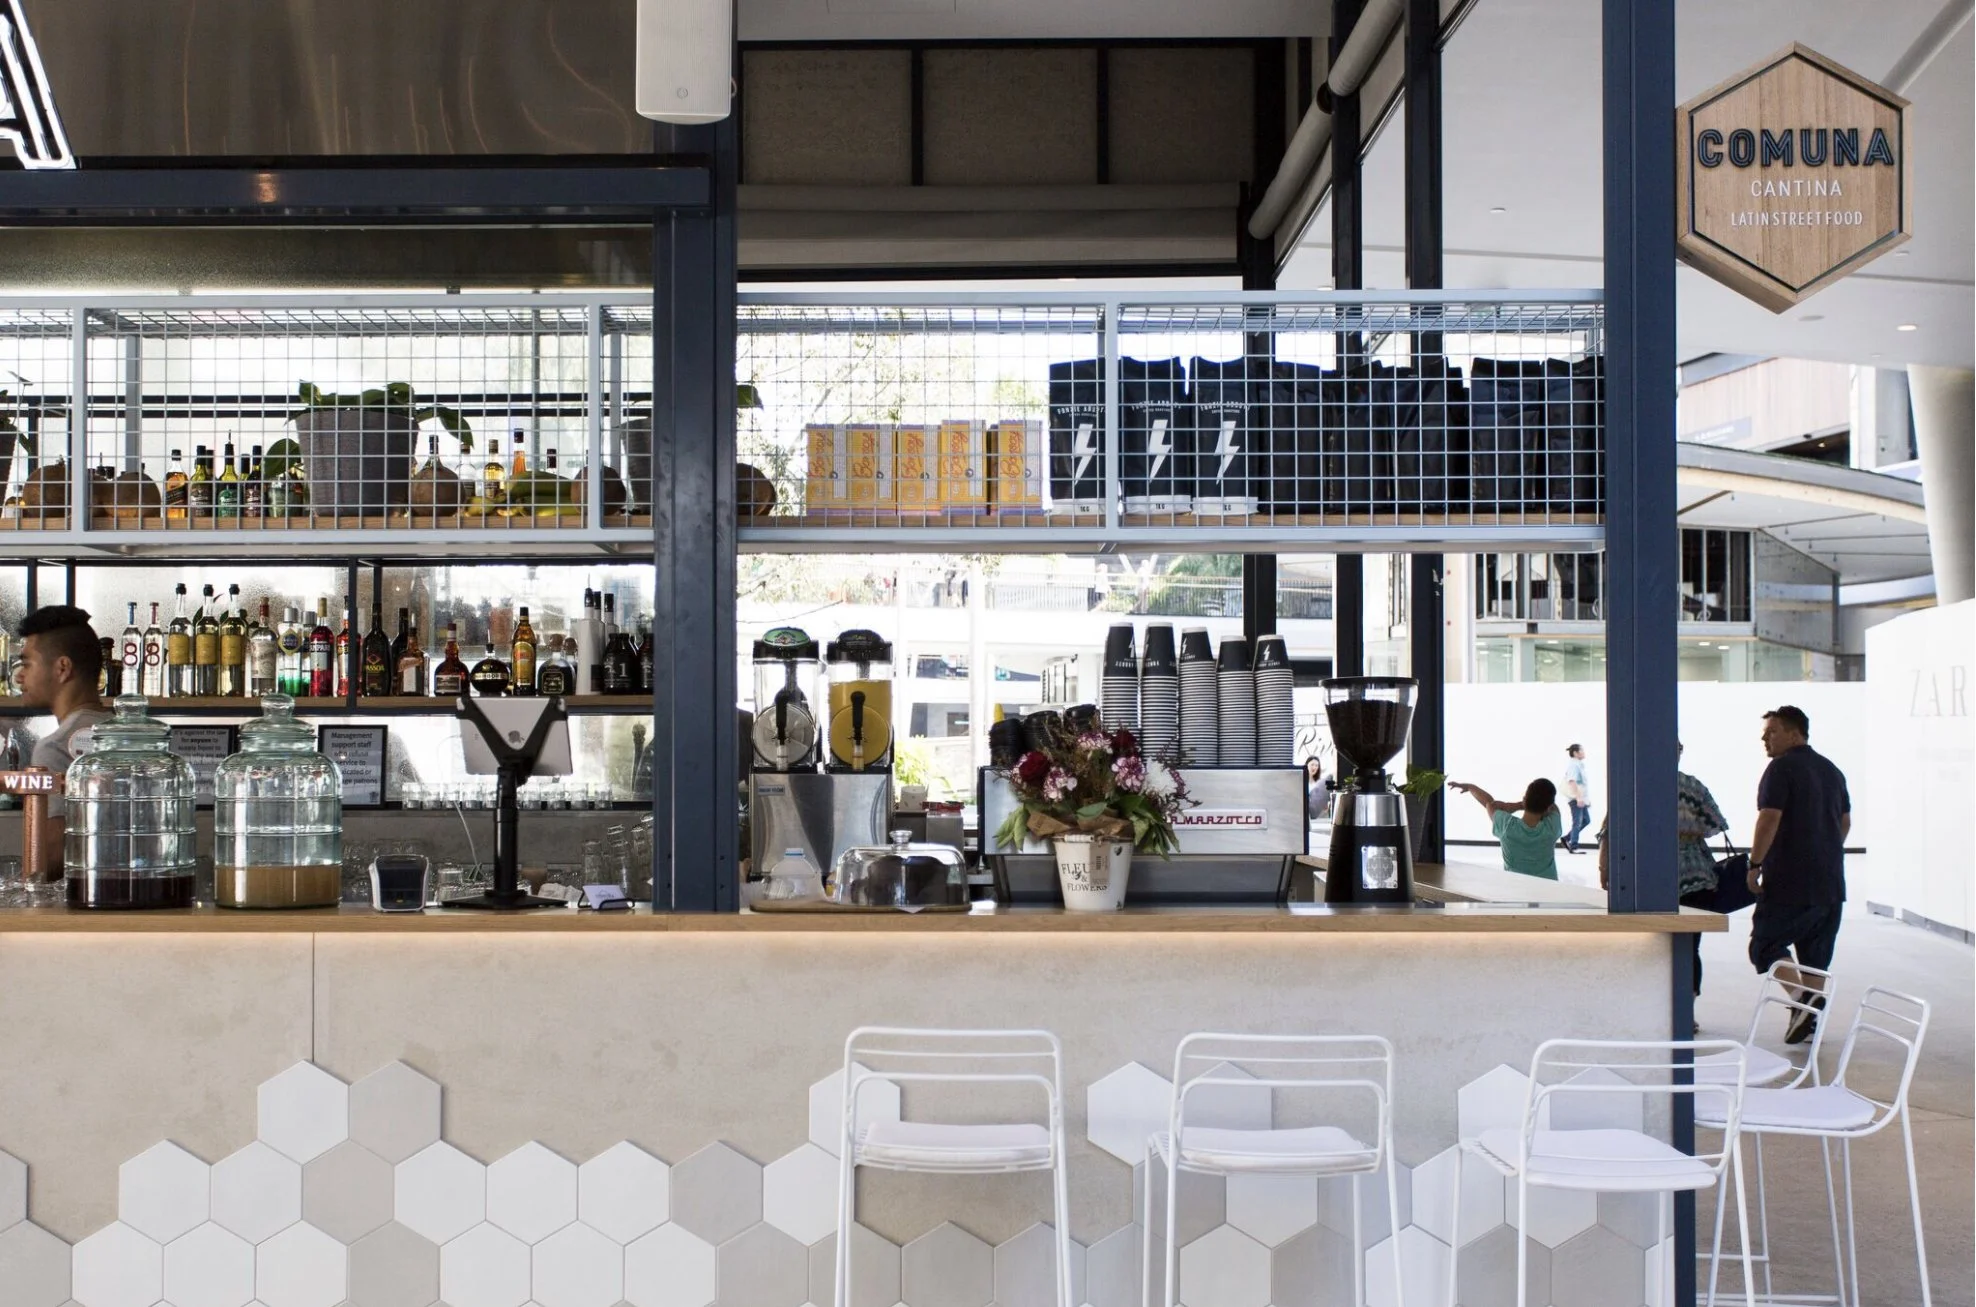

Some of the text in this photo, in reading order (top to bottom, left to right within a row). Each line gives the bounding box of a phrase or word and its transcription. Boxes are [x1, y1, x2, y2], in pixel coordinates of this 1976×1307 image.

[1697, 128, 1895, 168] COMUNA
[1750, 179, 1843, 197] CANTINA
[1731, 211, 1863, 226] LATIN STREET FOOD
[124, 642, 138, 666] 8
[144, 642, 160, 666] 8
[4, 775, 53, 789] WINE
[1061, 863, 1091, 875] FLEU
